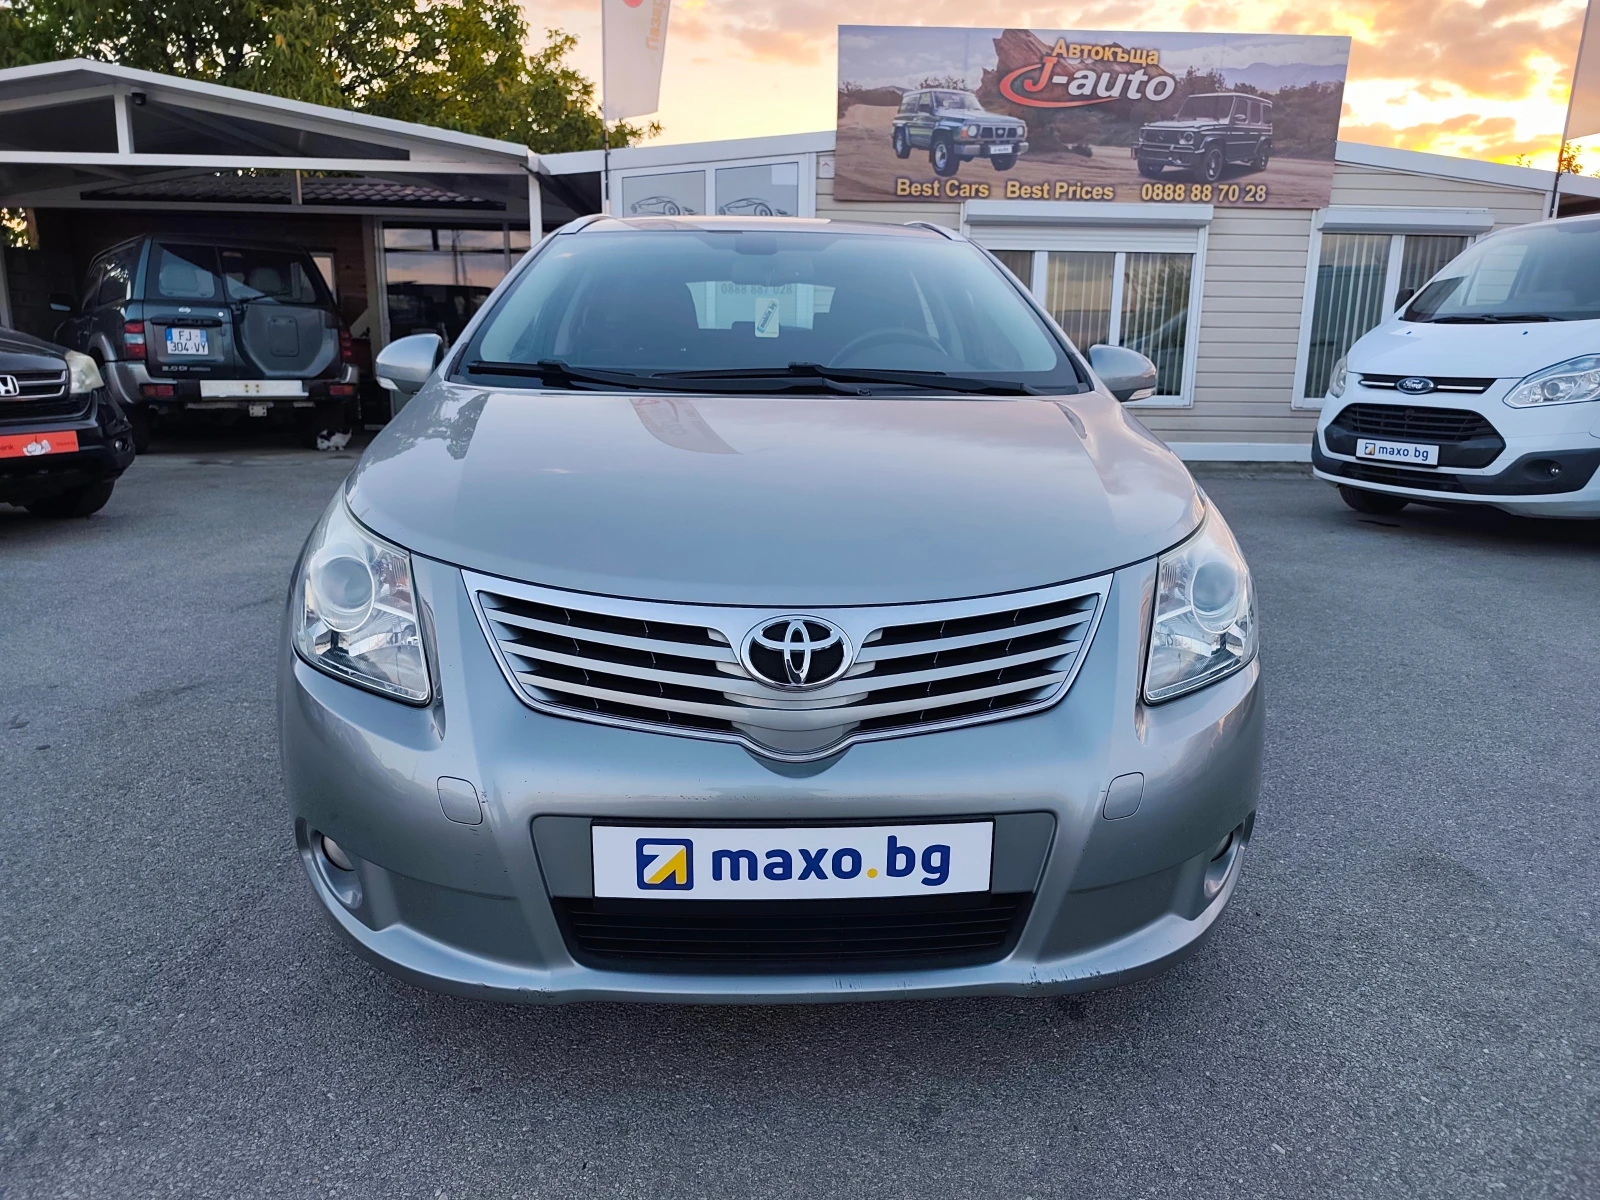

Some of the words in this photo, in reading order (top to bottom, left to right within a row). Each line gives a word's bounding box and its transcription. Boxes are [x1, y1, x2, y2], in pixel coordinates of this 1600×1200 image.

[1052, 39, 1159, 67] Автокъща
[1023, 56, 1175, 101] J-auto
[897, 179, 940, 198] Best
[945, 179, 989, 198] Cars
[1006, 180, 1051, 199] Best
[1055, 181, 1114, 201] Prices
[1141, 183, 1185, 202] 0888
[1190, 184, 1212, 202] 88
[1217, 184, 1239, 202] 70
[1243, 184, 1266, 203] 28
[1403, 379, 1424, 389] Ford
[1378, 445, 1429, 461] maxo.bg
[711, 835, 951, 886] maxo.bg
